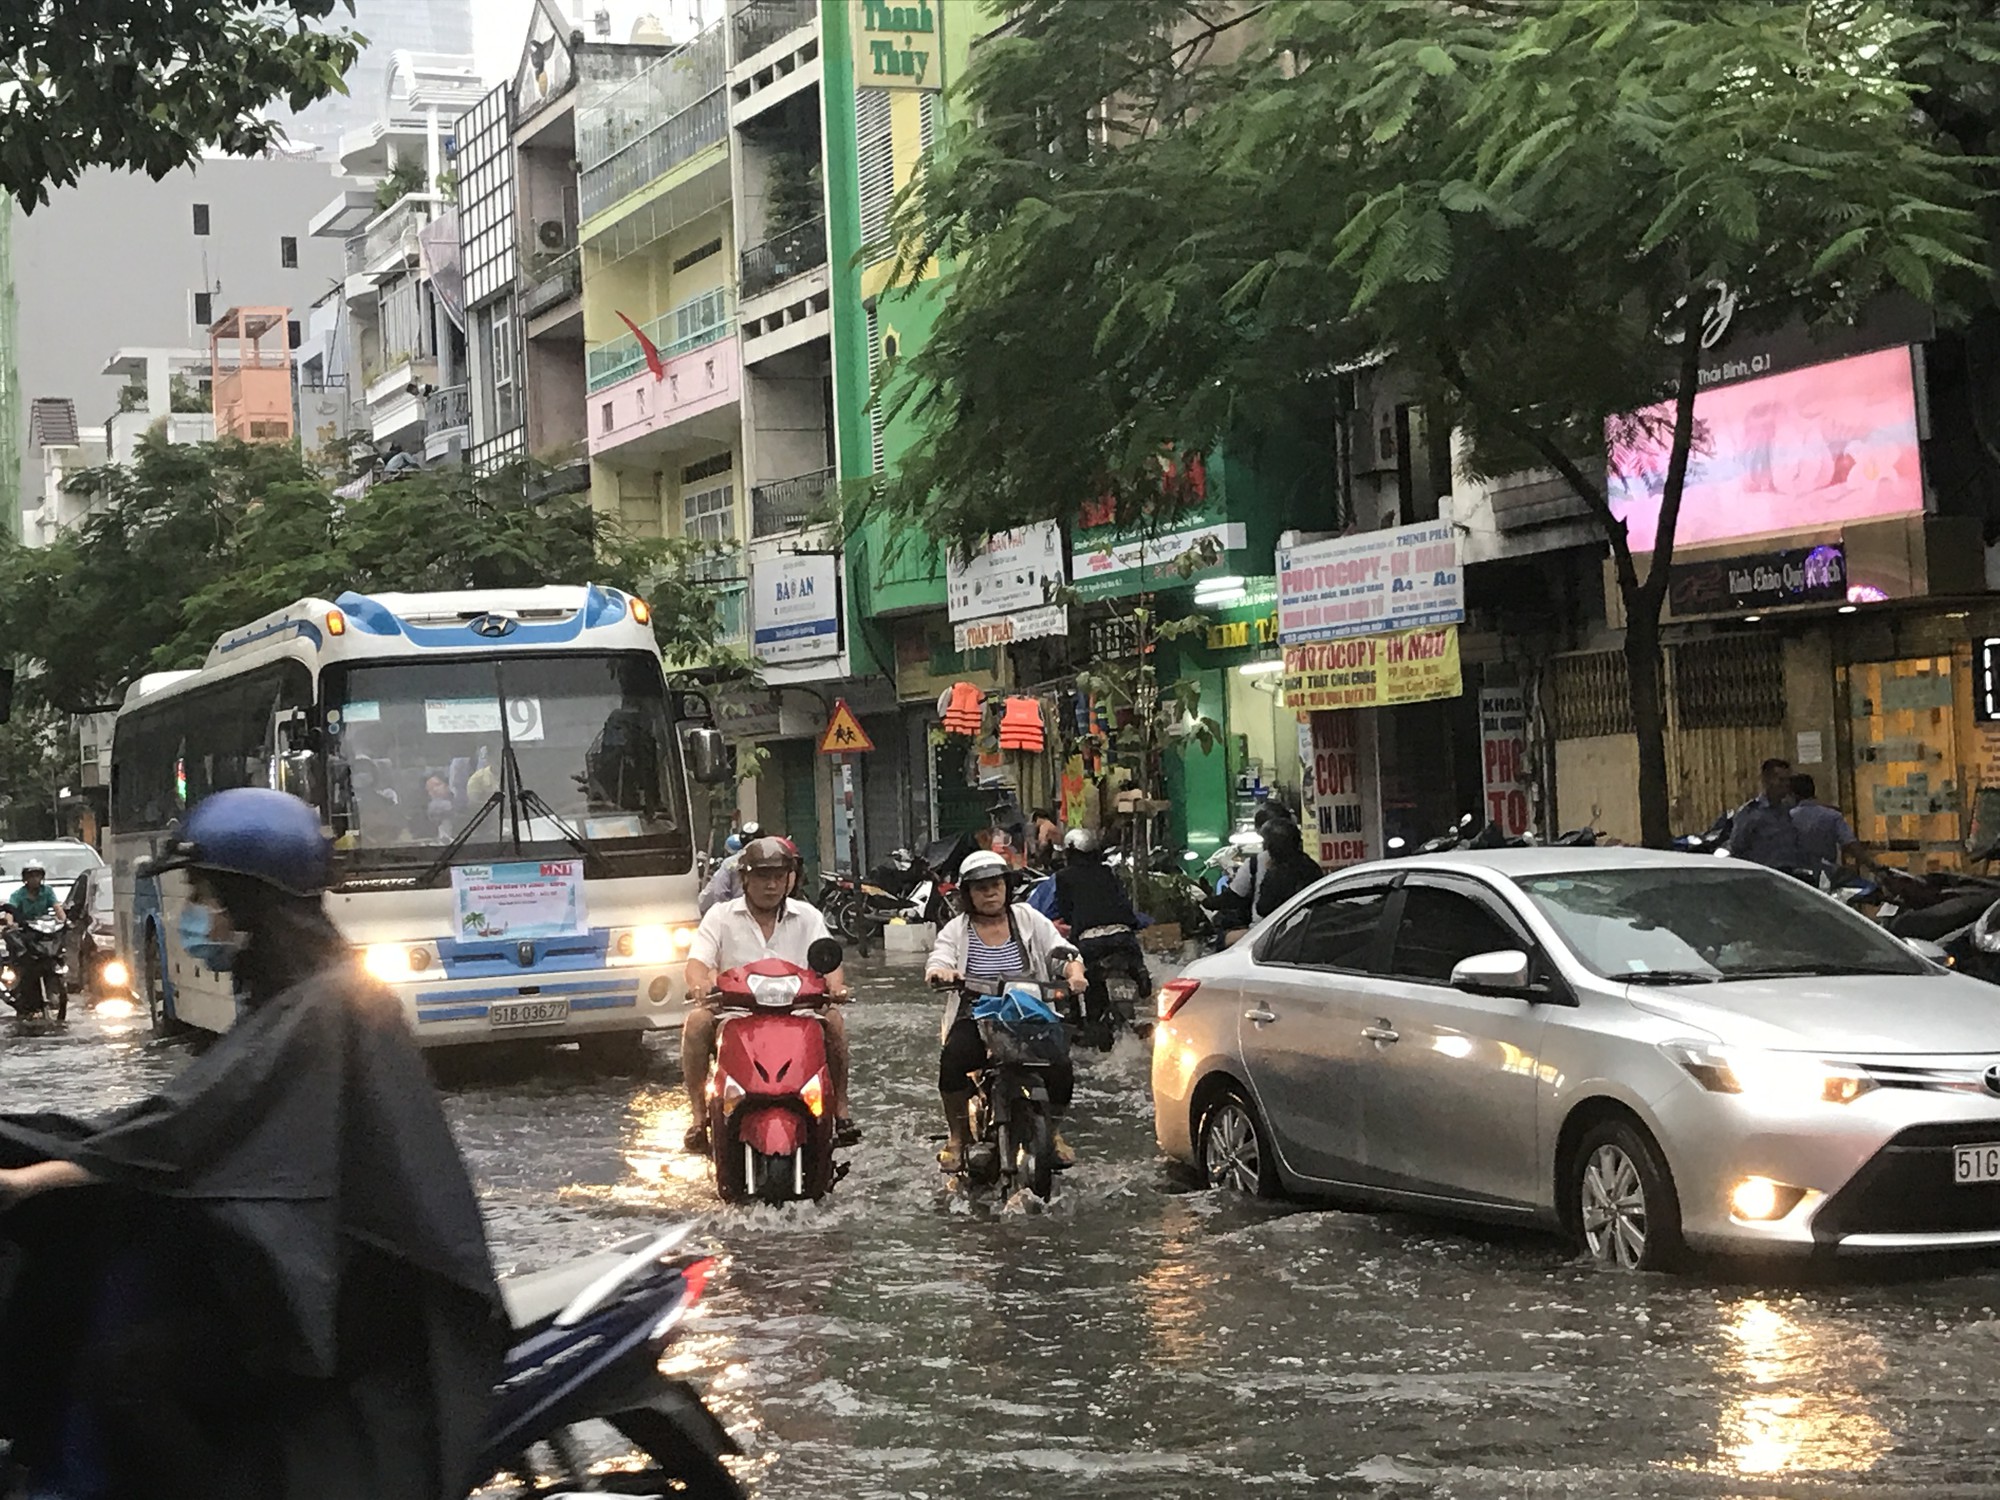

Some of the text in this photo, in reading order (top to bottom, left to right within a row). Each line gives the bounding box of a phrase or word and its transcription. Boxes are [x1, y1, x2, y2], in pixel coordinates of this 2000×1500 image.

[1282, 556, 1381, 595] PHOTOCOPY
[1284, 640, 1376, 675] PHOTOCOPY
[509, 699, 538, 738] 9
[1315, 753, 1357, 796] COPY
[1488, 789, 1528, 836] TO
[1958, 1150, 1999, 1179] 51G
